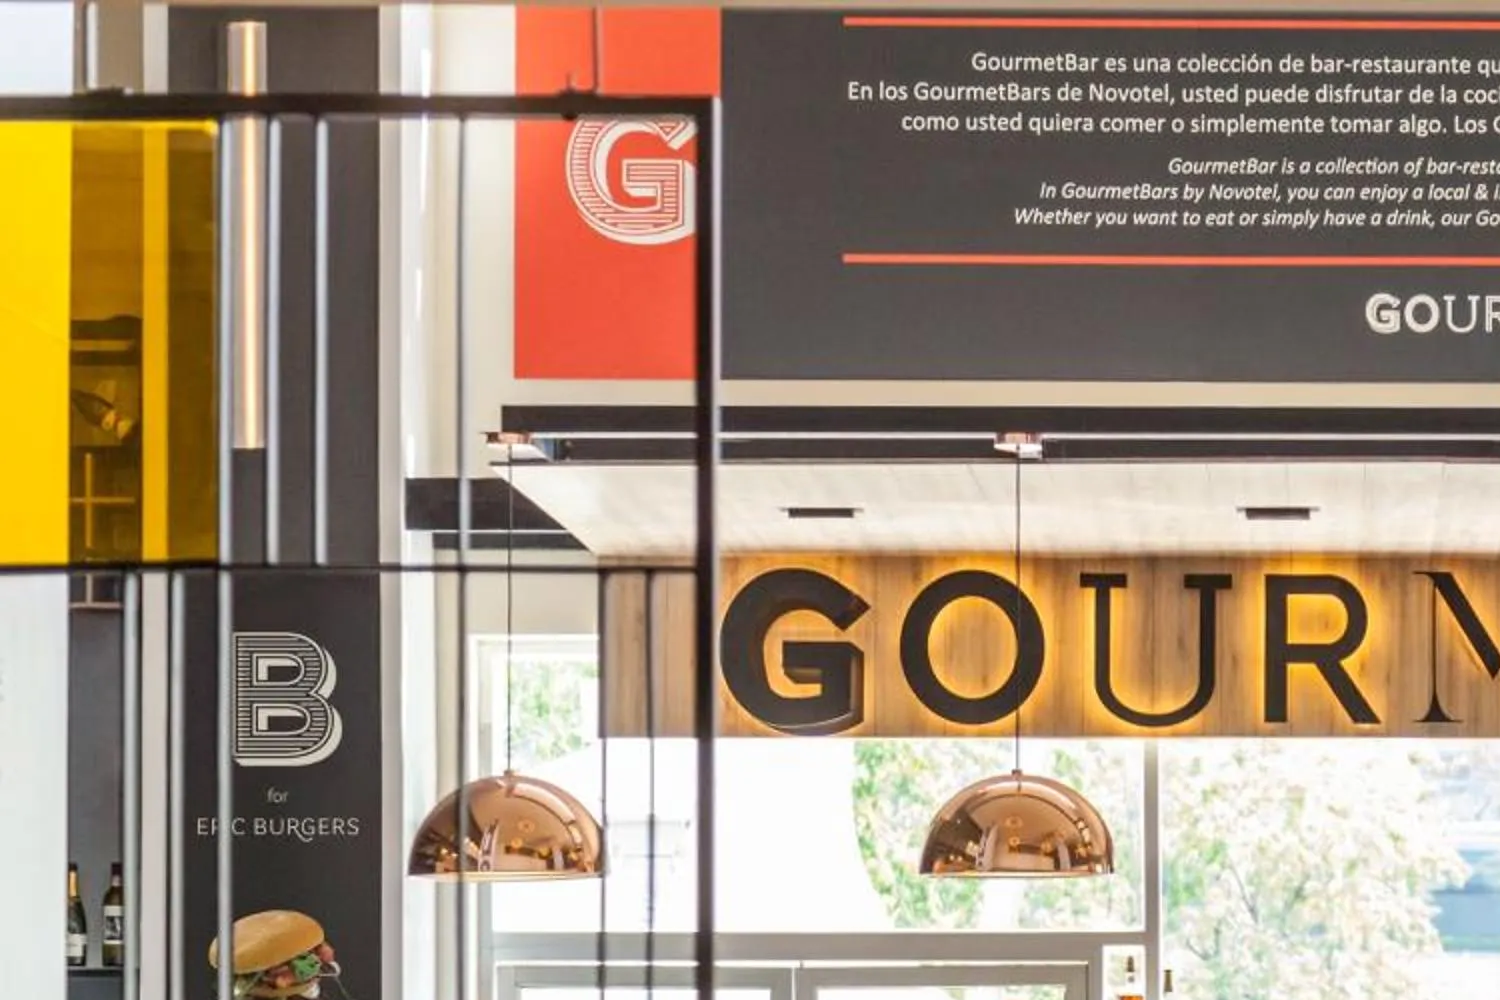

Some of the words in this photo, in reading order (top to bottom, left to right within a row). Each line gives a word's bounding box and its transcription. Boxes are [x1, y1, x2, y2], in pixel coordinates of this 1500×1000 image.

[970, 51, 1100, 73] GourmetBar
[1103, 56, 1128, 73] es
[1132, 57, 1171, 73] una
[1176, 52, 1273, 74] colección
[1278, 52, 1305, 74] de
[1310, 53, 1472, 75] bar-restaurante
[847, 80, 874, 101] En
[878, 79, 909, 102] los
[913, 81, 1052, 103] GourmetBars
[1056, 81, 1083, 103] de
[1088, 81, 1176, 106] Novotel,
[1181, 83, 1239, 104] usted
[1244, 83, 1310, 108] puede
[1314, 82, 1404, 105] disfrutar
[1408, 83, 1435, 105] de
[1439, 83, 1458, 105] la
[901, 115, 961, 132] como
[965, 111, 1023, 133] usted
[1027, 112, 1095, 137] quiera
[1099, 115, 1167, 133] comer
[1170, 117, 1186, 134] o
[1189, 112, 1326, 138] simplemente
[1329, 115, 1394, 134] tomar
[1398, 112, 1448, 139] algo.
[1453, 115, 1488, 136] Los
[565, 112, 697, 245] G
[1167, 157, 1278, 175] GourmetBar
[1281, 157, 1296, 175] is
[1298, 161, 1311, 175] a
[1315, 156, 1400, 175] collection
[1403, 157, 1423, 179] of
[1040, 182, 1057, 200] In
[1060, 182, 1180, 201] GourmetBars
[1183, 183, 1205, 205] by
[1209, 183, 1283, 204] Novotel,
[1287, 187, 1320, 205] you
[1323, 187, 1356, 201] can
[1360, 184, 1408, 205] enjoy
[1412, 187, 1424, 201] a
[1428, 183, 1470, 201] local
[1474, 184, 1490, 202] &
[1013, 208, 1092, 226] Whether
[1095, 212, 1128, 229] you
[1132, 210, 1178, 227] want
[1182, 211, 1202, 228] to
[1205, 210, 1236, 228] eat
[1239, 213, 1259, 228] or
[1262, 208, 1320, 231] simply
[1323, 209, 1367, 227] have
[1369, 213, 1383, 227] a
[1386, 208, 1437, 229] drink,
[1441, 212, 1472, 227] our
[232, 631, 343, 767] B
[267, 786, 289, 803] for
[197, 816, 246, 836] EC
[253, 816, 361, 842] BURGERS
